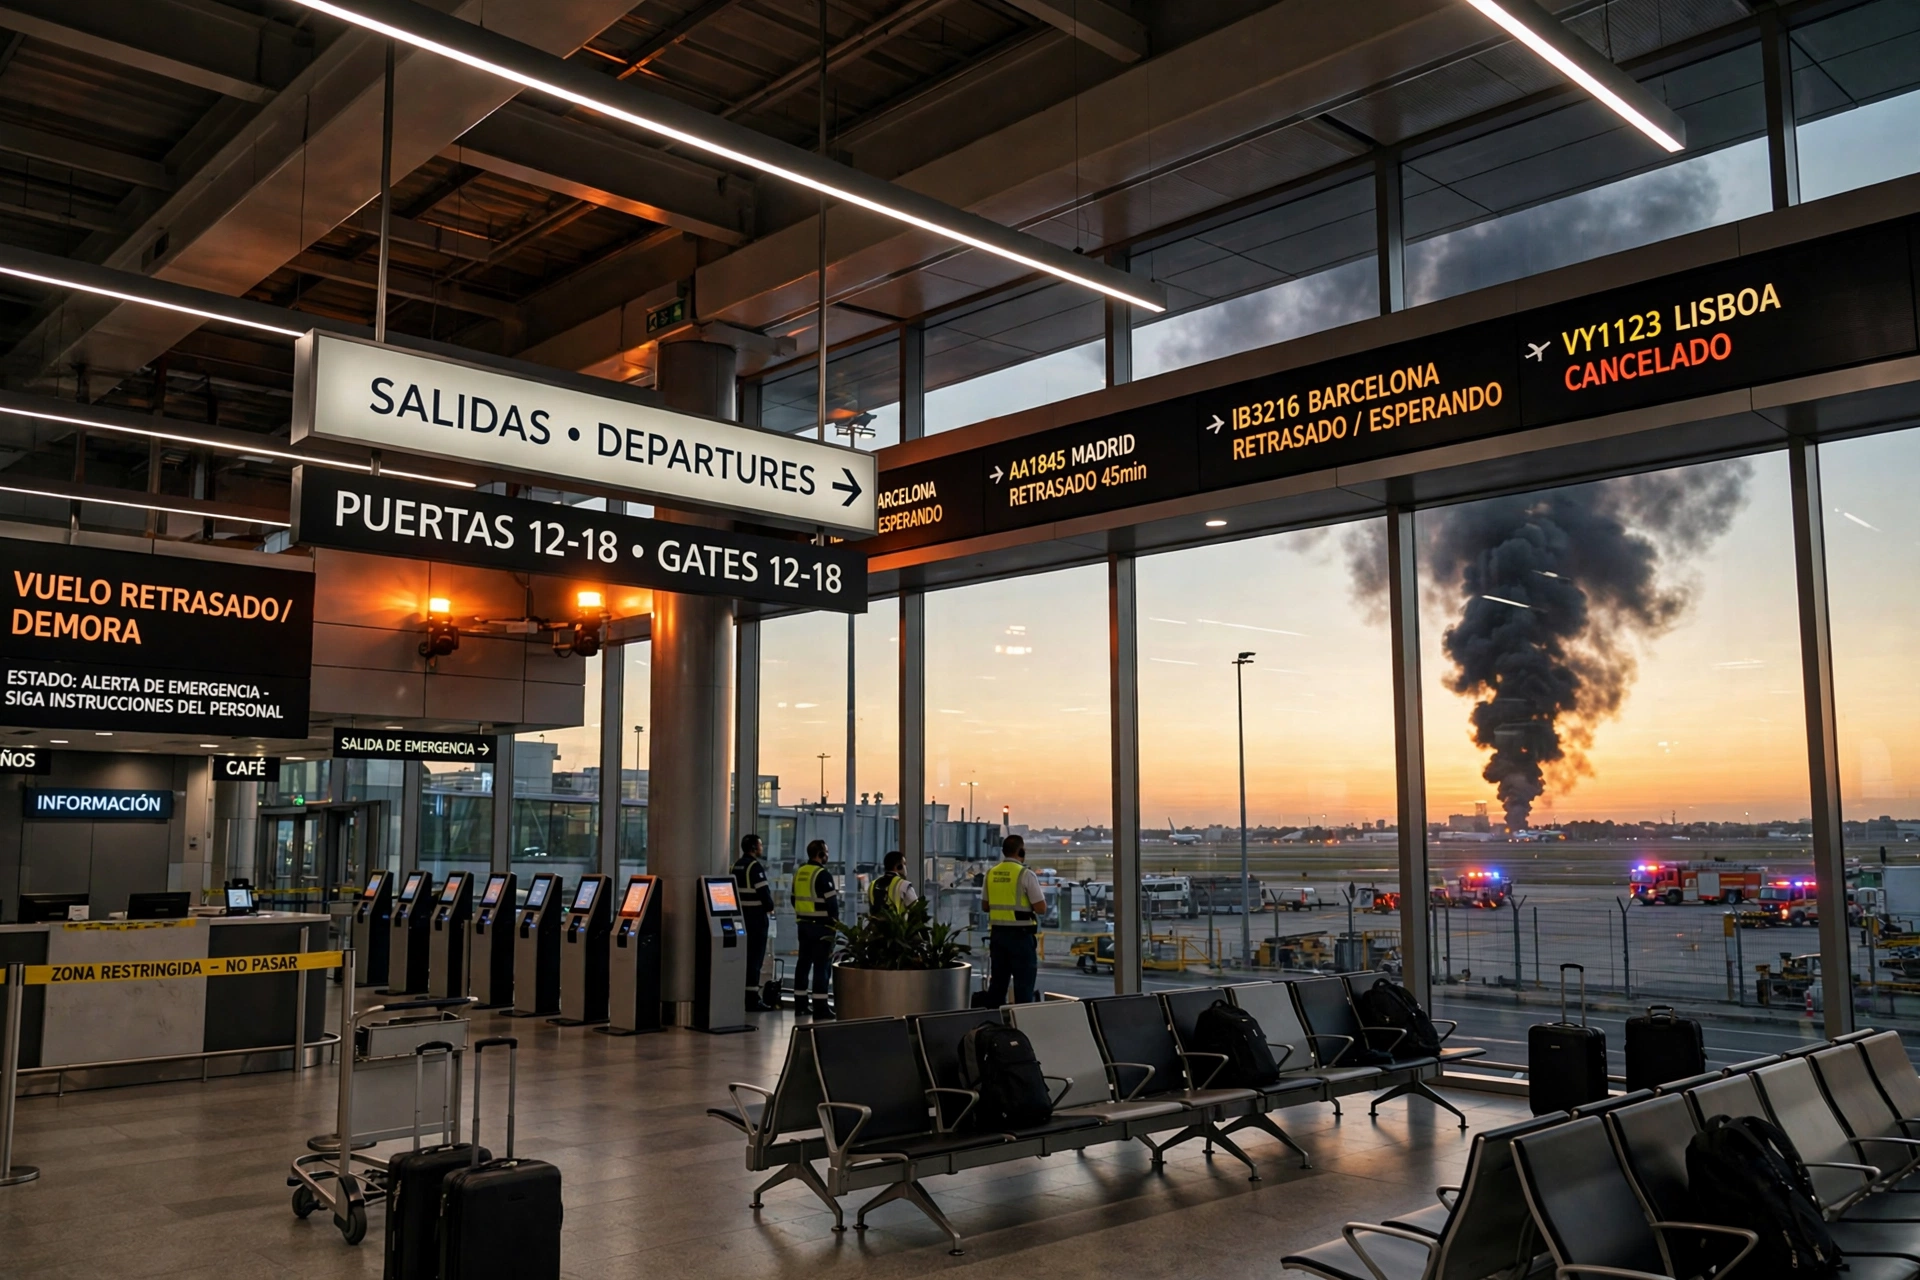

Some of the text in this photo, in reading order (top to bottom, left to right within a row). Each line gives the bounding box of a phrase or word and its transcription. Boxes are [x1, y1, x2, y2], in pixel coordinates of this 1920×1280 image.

[1562, 283, 1782, 356] VY1123 LISBOA
[1564, 333, 1732, 391] CANCELADO
[1232, 362, 1440, 431] IB3216 BARCELONA
[369, 376, 816, 496] SALIDAS DEPARTURES
[1233, 416, 1347, 461] RETRASADO
[1369, 382, 1503, 432] ESPERANDO
[1009, 433, 1136, 480] AA1845 MADRID
[877, 481, 937, 509] ARCELONA
[1009, 461, 1147, 507] RETRASADO 45min
[879, 504, 943, 534] ESPERANDO
[335, 490, 843, 594] PUERTAS 12-18 GATES 12-18
[14, 570, 293, 623] VUELO RETRASADO/
[12, 608, 142, 645] DEMORA
[5, 690, 284, 719] SIGA INSTRUCCIONES DEL PERSONAL
[7, 670, 77, 689] ESTADO:
[81, 674, 140, 693] ALERTA
[144, 679, 165, 695] DE
[168, 680, 260, 699] EMERGENCIA
[341, 737, 475, 755] SALIDA DE EMERGENCIA
[225, 758, 267, 776] CAFÉ
[37, 793, 161, 812] INFORMACIÓN
[51, 966, 96, 982] ZONA
[101, 961, 203, 979] RESTRINGIDA
[225, 959, 248, 973] NO
[251, 956, 298, 972] PASAR
